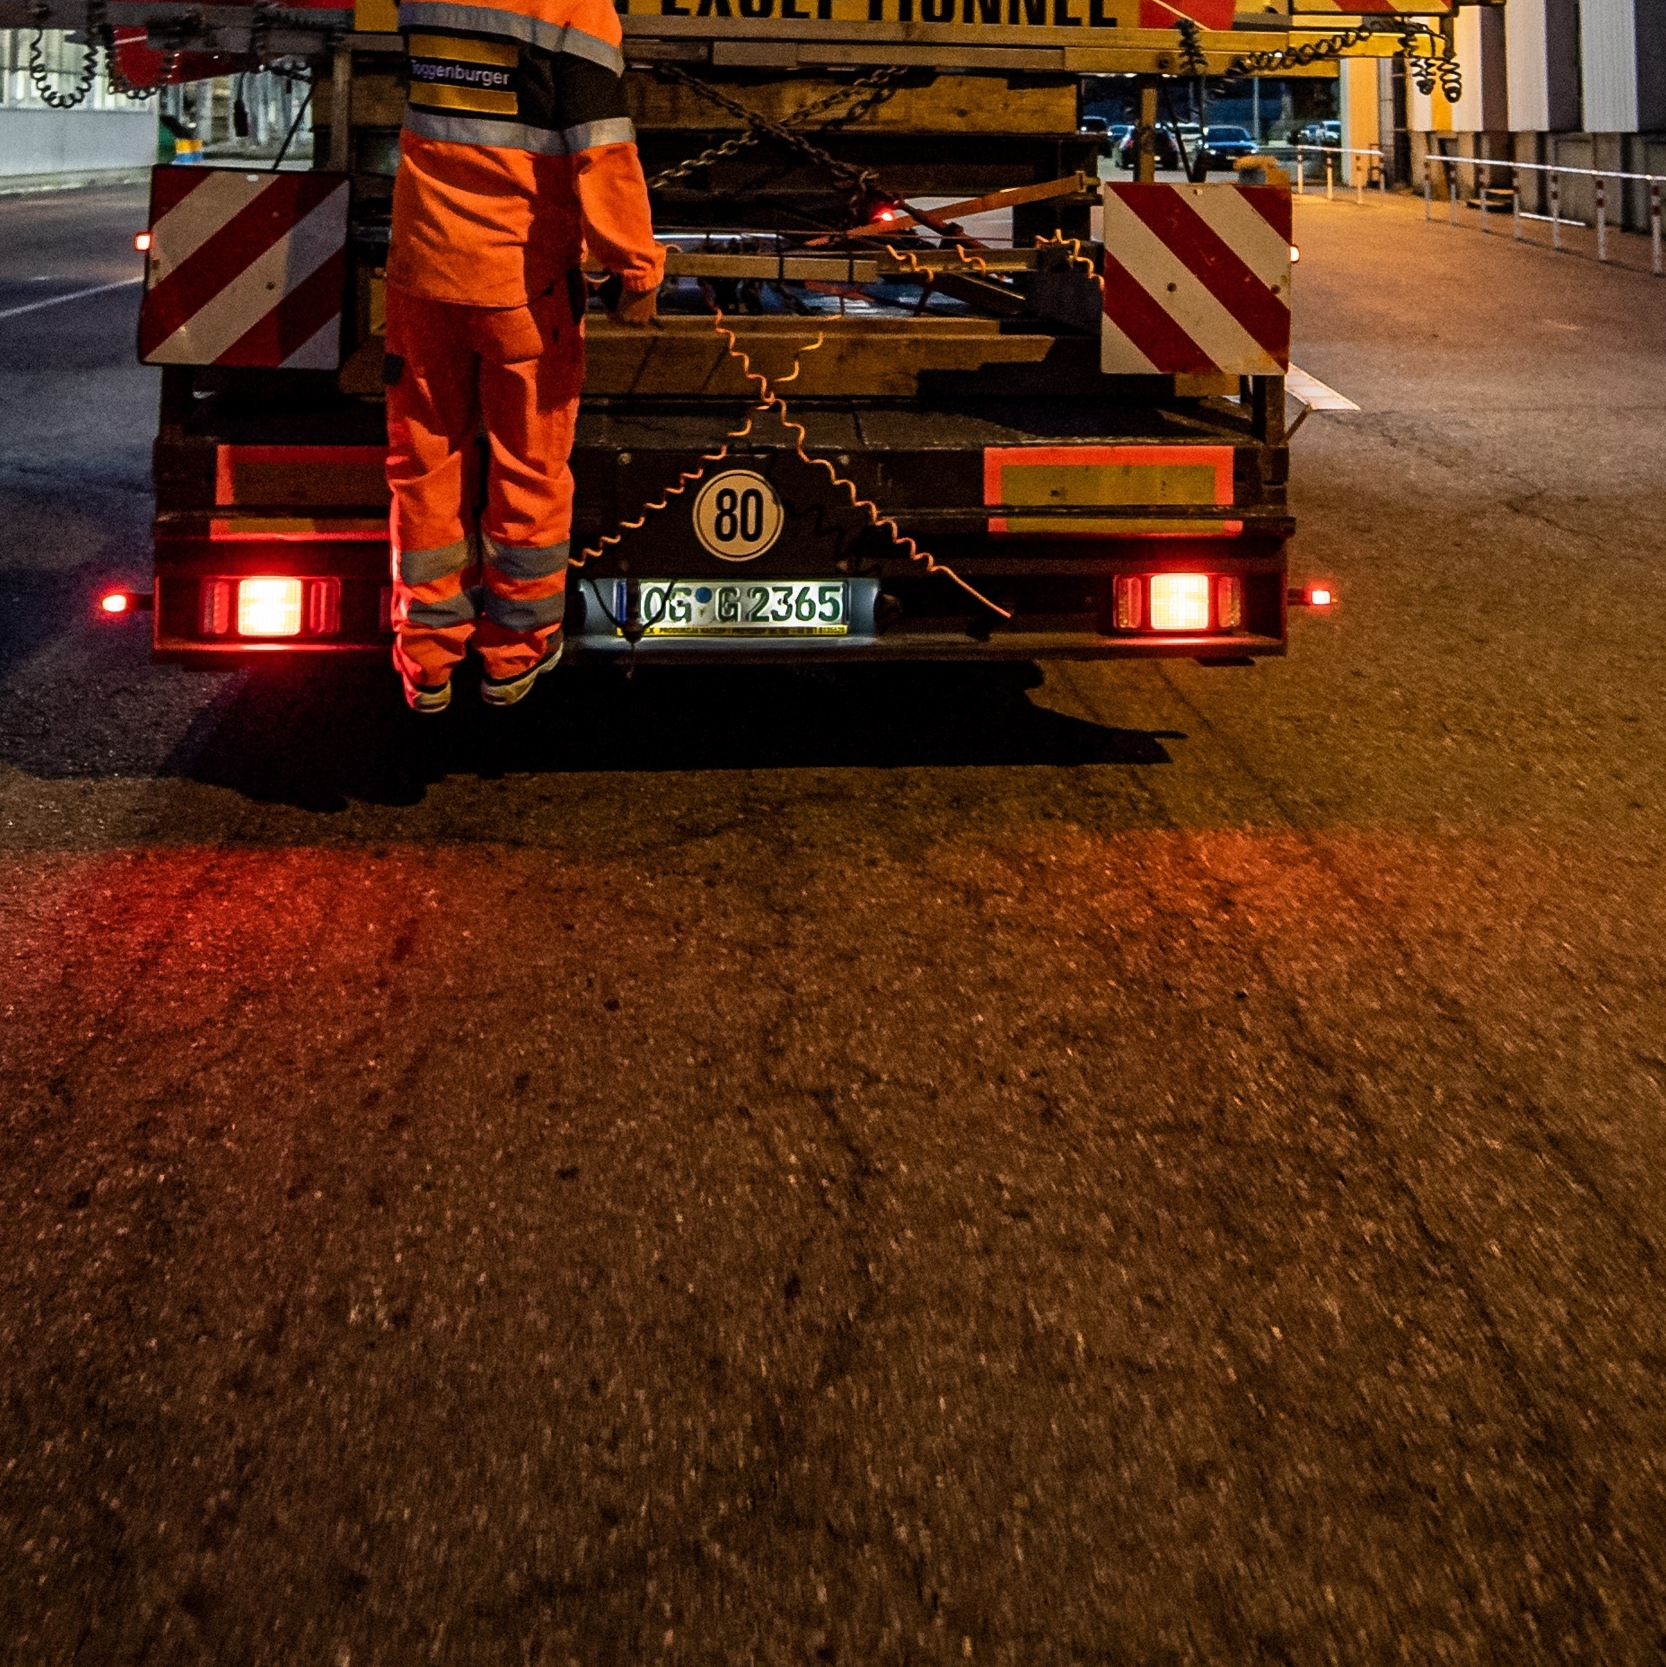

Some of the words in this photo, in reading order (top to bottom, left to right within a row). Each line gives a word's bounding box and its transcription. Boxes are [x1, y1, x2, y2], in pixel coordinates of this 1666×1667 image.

[410, 59, 511, 86] Toggenburger
[714, 487, 764, 543] 80
[747, 585, 843, 623] 2365
